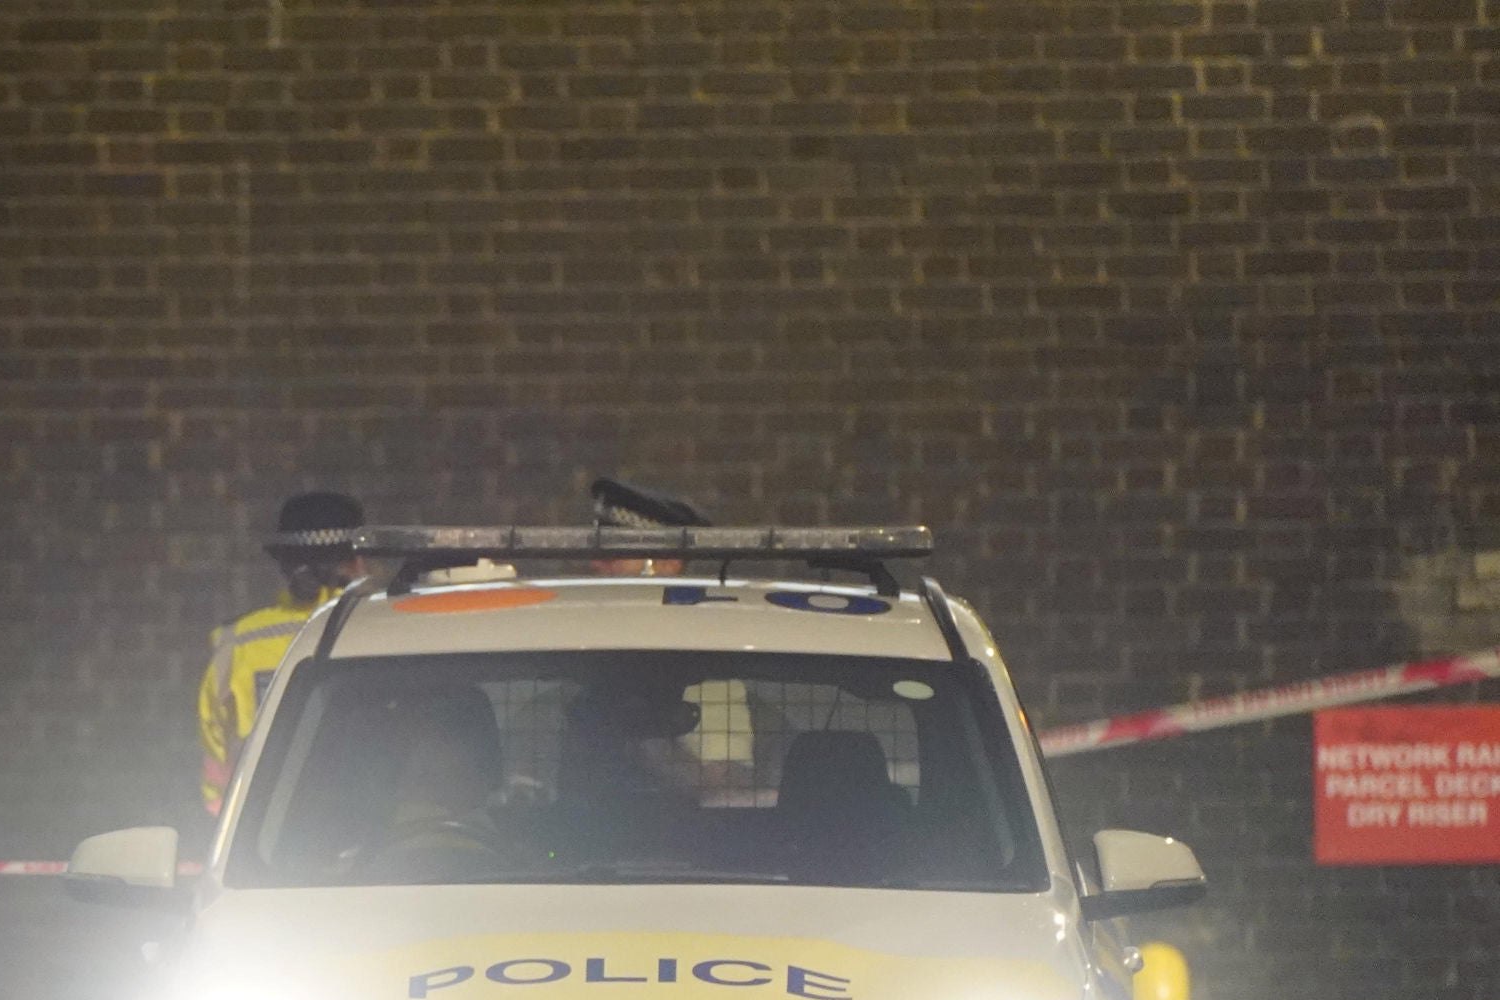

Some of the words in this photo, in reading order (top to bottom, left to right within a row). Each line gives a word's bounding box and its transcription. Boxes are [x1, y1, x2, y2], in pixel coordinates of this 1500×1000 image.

[1317, 742, 1449, 769] NETWORK
[1325, 771, 1430, 799] PARCEL
[1347, 802, 1401, 828] DRY
[1408, 801, 1488, 828] RISER
